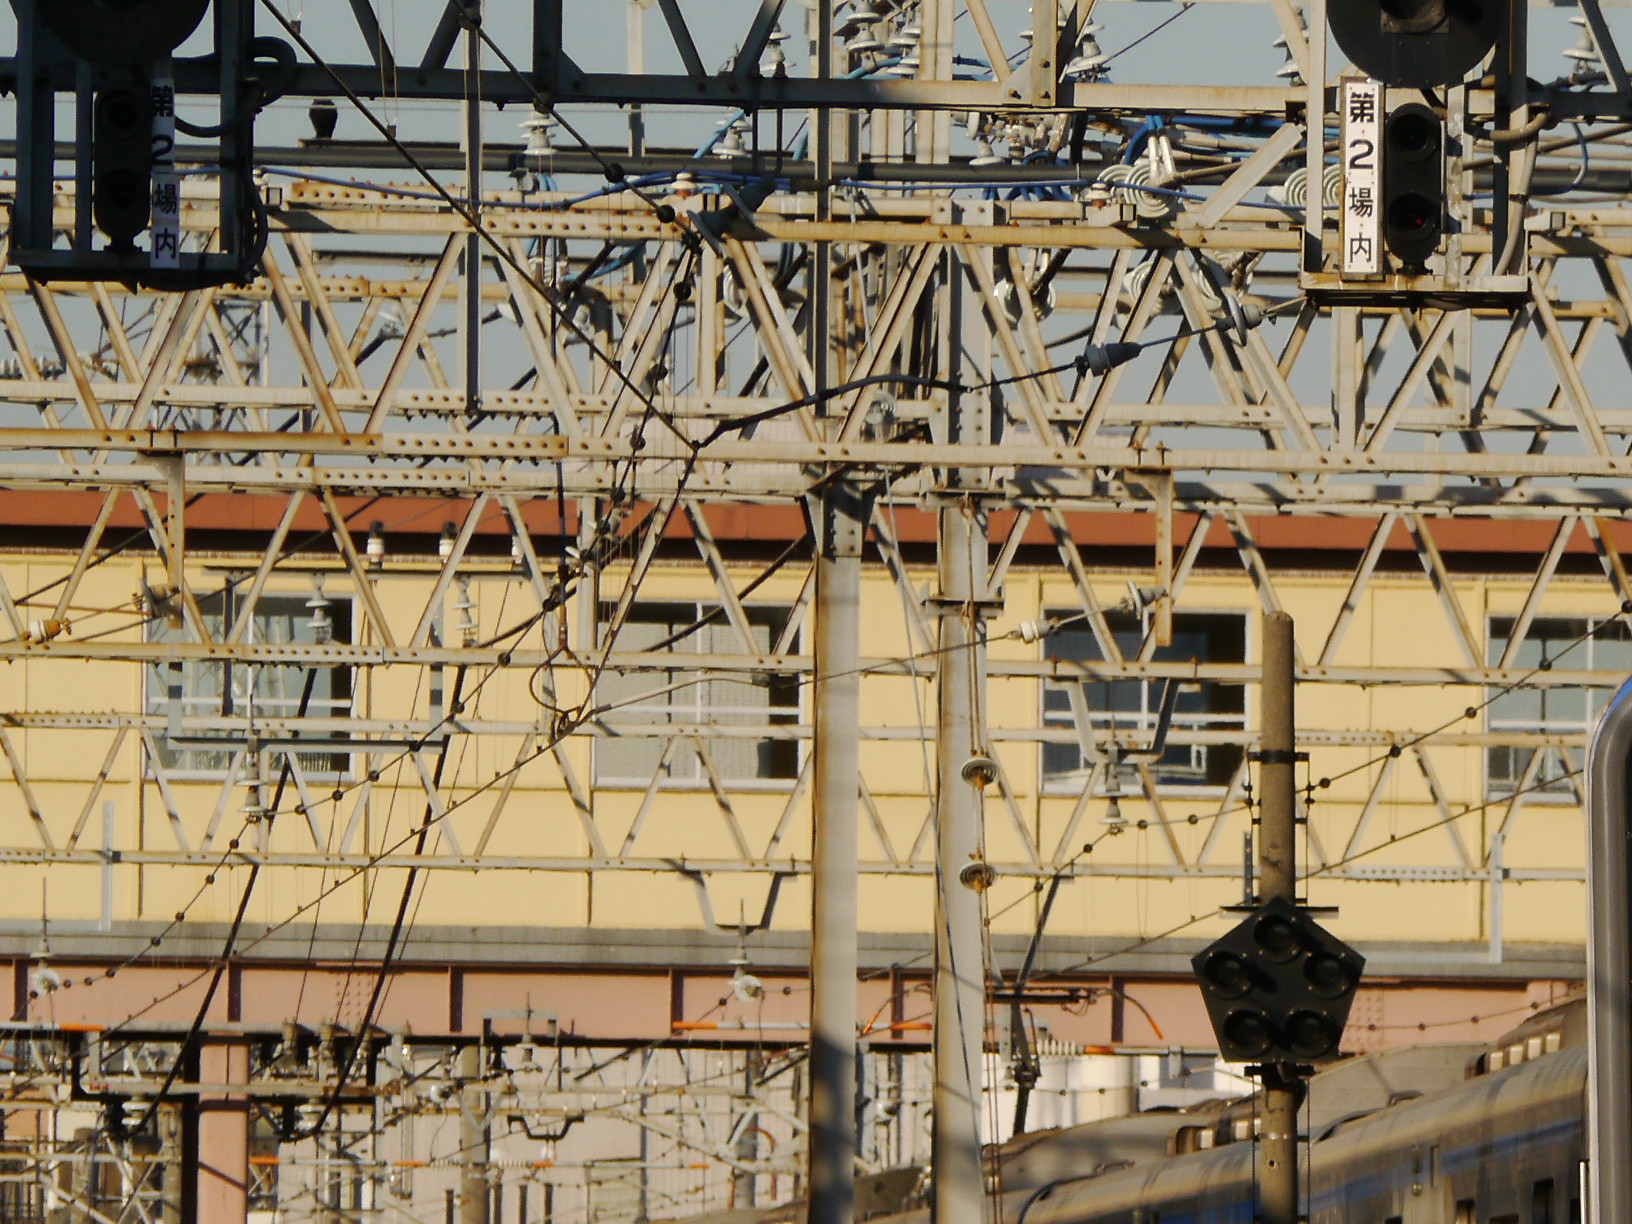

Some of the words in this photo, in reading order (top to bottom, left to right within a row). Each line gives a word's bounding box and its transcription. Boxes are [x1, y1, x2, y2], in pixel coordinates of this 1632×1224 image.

[151, 85, 178, 260] 第2場内
[1348, 91, 1376, 264] 第2場内
